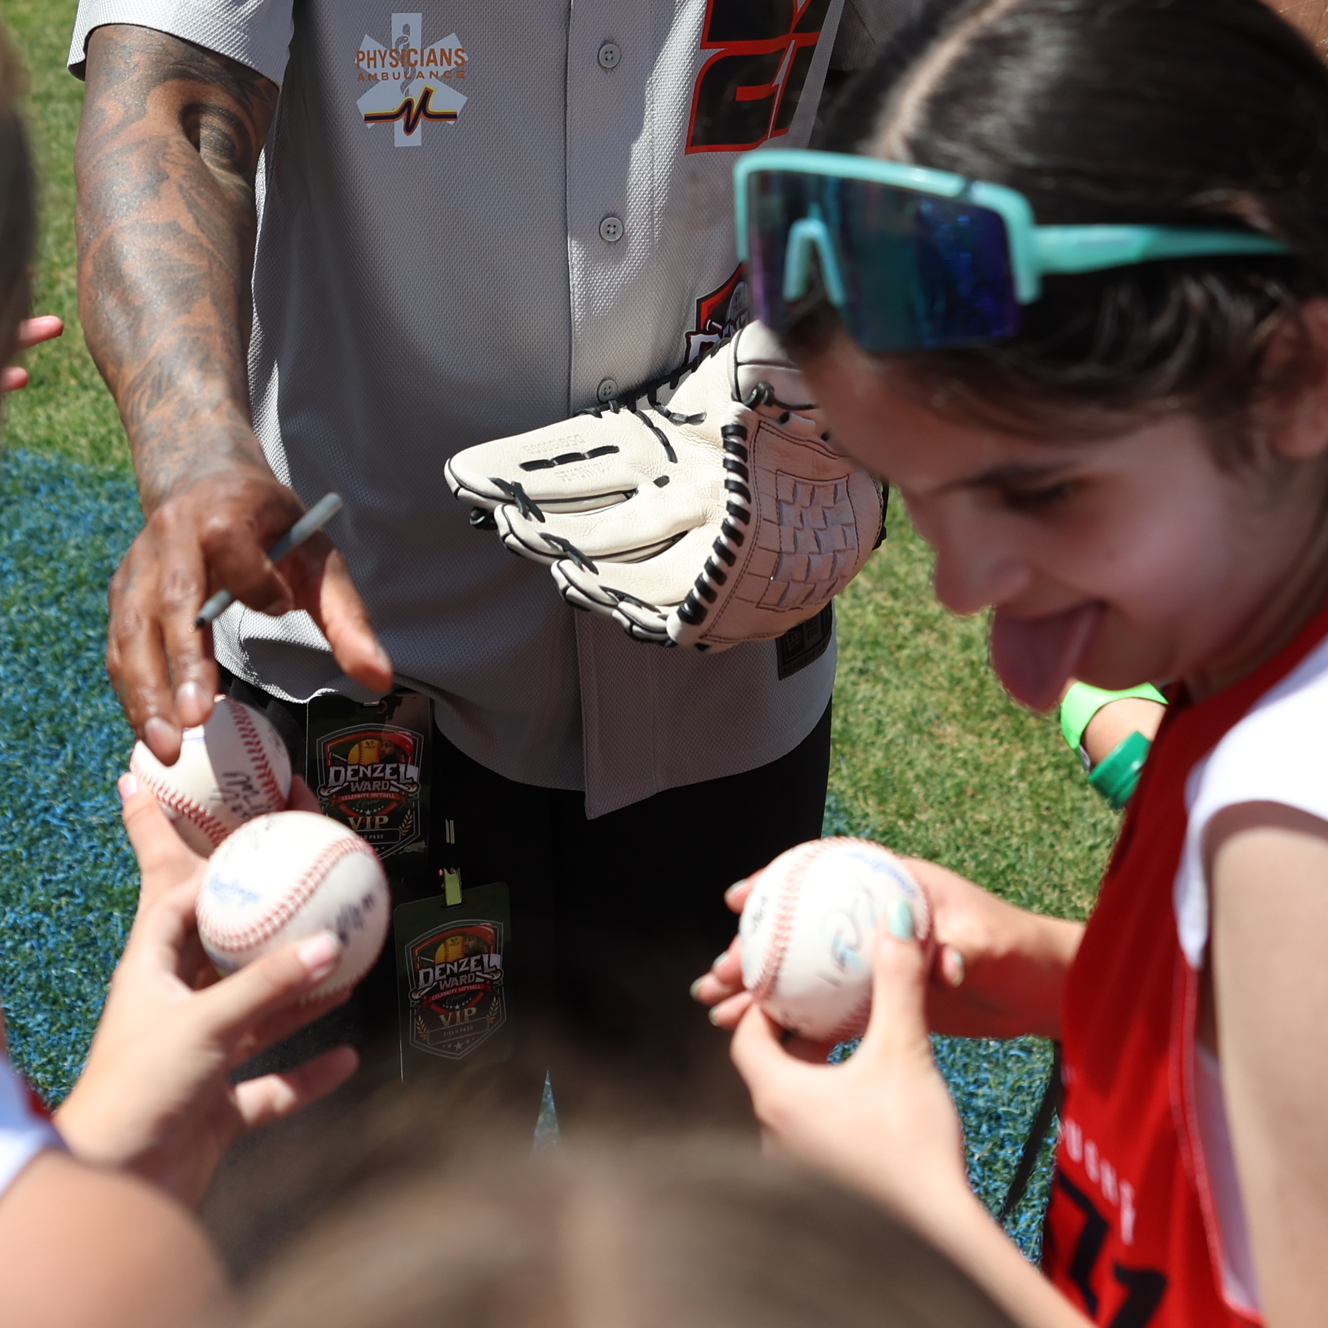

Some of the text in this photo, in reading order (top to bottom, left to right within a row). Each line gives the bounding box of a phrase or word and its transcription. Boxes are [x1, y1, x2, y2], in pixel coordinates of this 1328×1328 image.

[356, 47, 467, 69] PHYSICIANS
[357, 70, 466, 82] AMBULANCE
[328, 763, 414, 787] DENZEL
[350, 781, 391, 792] WARD
[347, 815, 390, 830] VIP
[417, 954, 498, 990] DENZEL
[439, 972, 476, 990] WARD
[439, 1007, 478, 1027] VIP
[443, 1028, 459, 1037] FIELD
